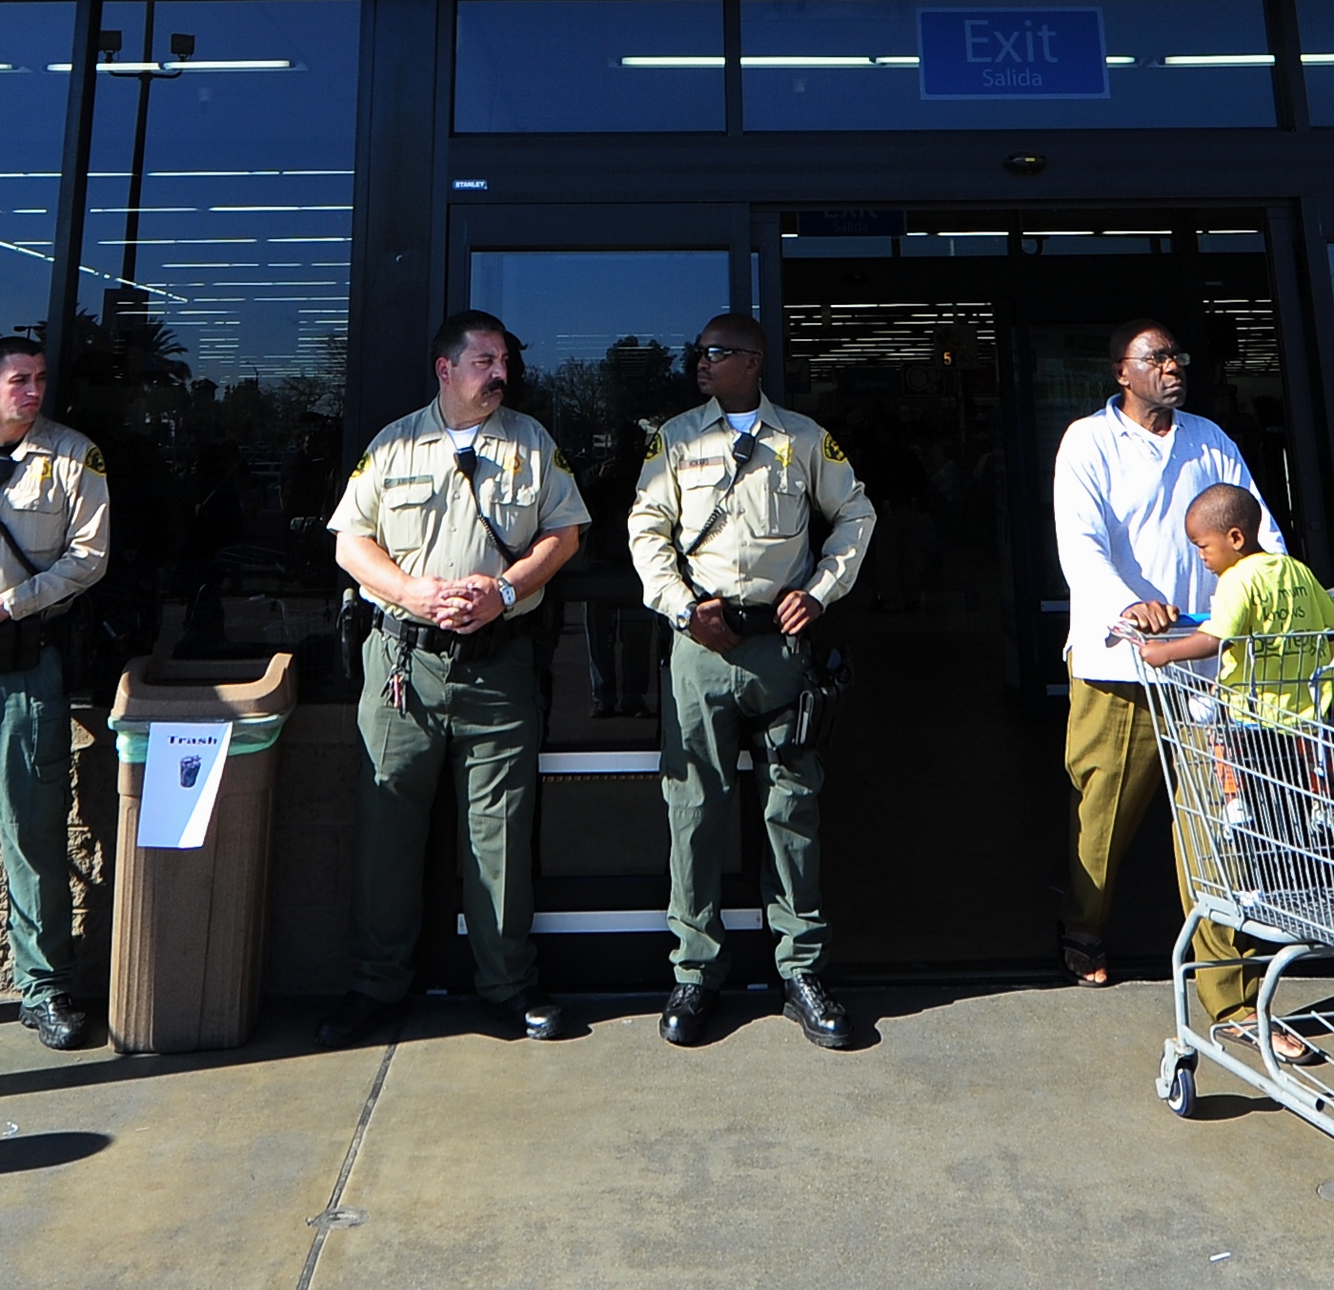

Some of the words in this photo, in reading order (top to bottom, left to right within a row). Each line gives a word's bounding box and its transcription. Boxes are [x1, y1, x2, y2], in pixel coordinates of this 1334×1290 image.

[964, 19, 1059, 64] Exit
[982, 67, 1044, 87] Salida
[942, 351, 953, 366] 5
[167, 734, 219, 746] Trash
